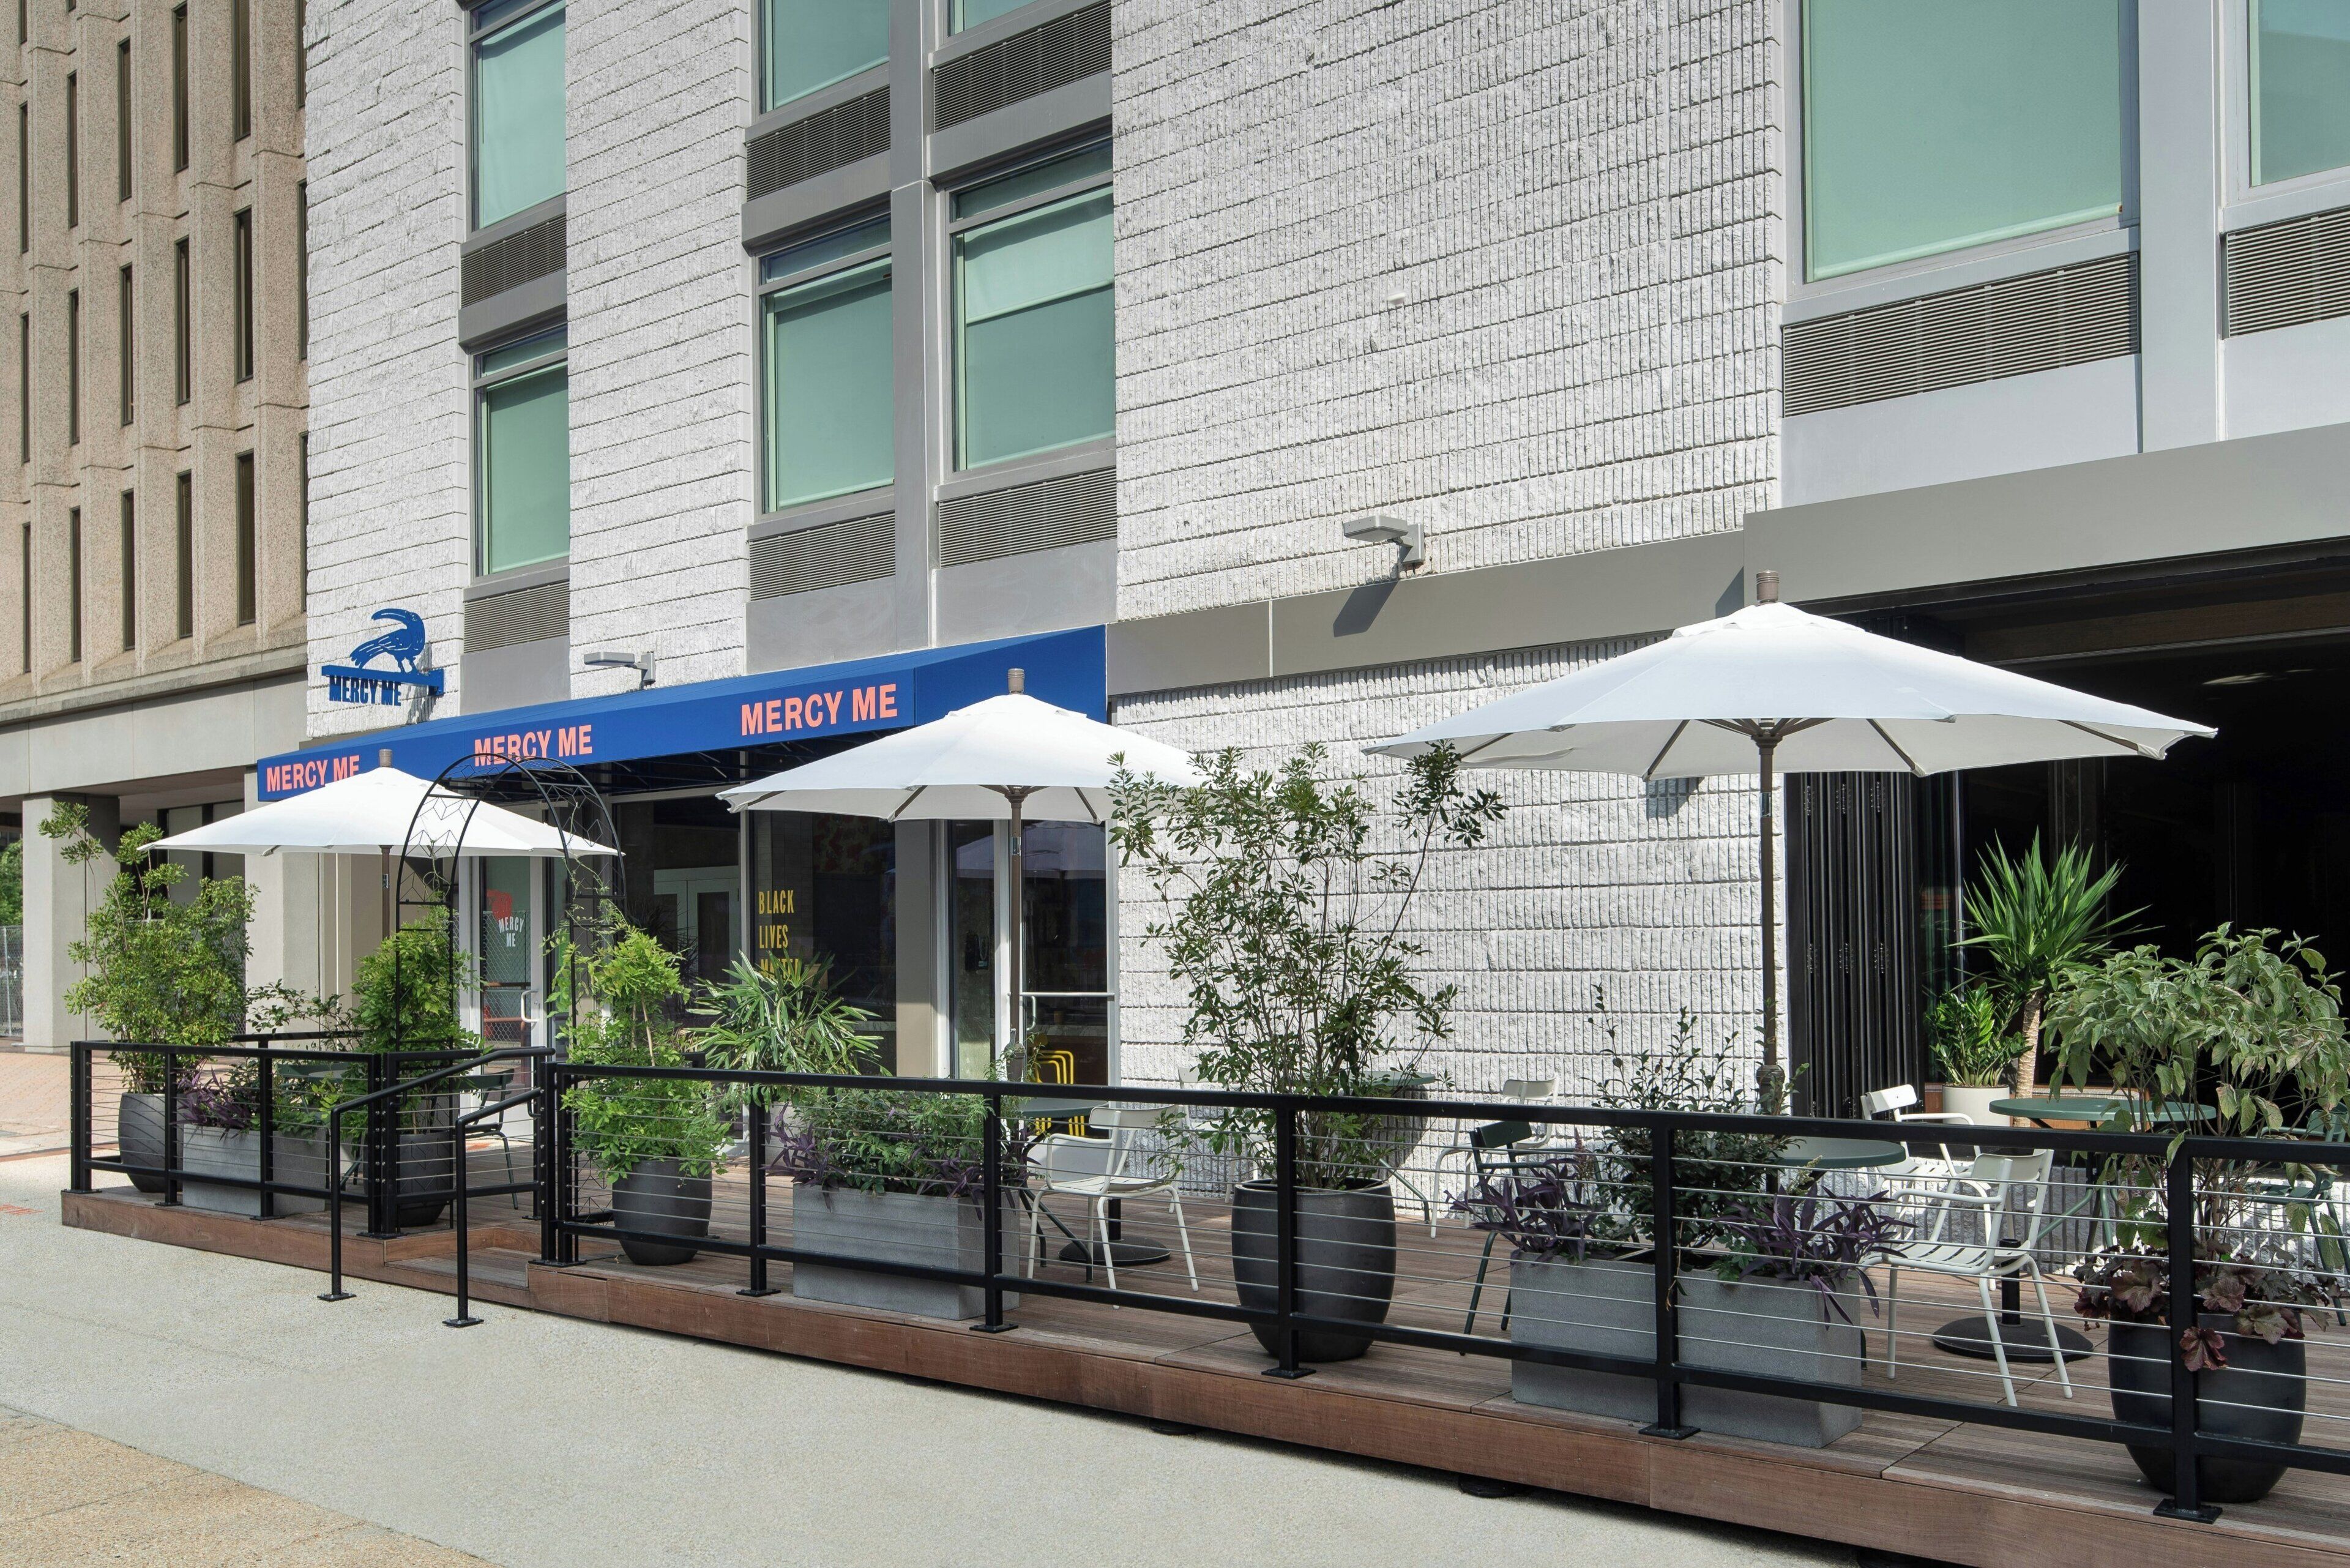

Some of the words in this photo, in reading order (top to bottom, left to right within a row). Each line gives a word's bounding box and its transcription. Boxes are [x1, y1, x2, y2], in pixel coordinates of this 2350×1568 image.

[329, 675, 378, 704] MERCY
[381, 679, 401, 706] ME
[741, 690, 843, 736] MERCY
[852, 683, 898, 722] ME
[474, 730, 552, 767] MERCY
[558, 725, 592, 757] ME
[266, 759, 328, 792] MERCY
[759, 890, 794, 914] BLACK
[498, 916, 524, 933] MERCY
[759, 924, 788, 949] LIVES
[506, 933, 516, 947] ME
